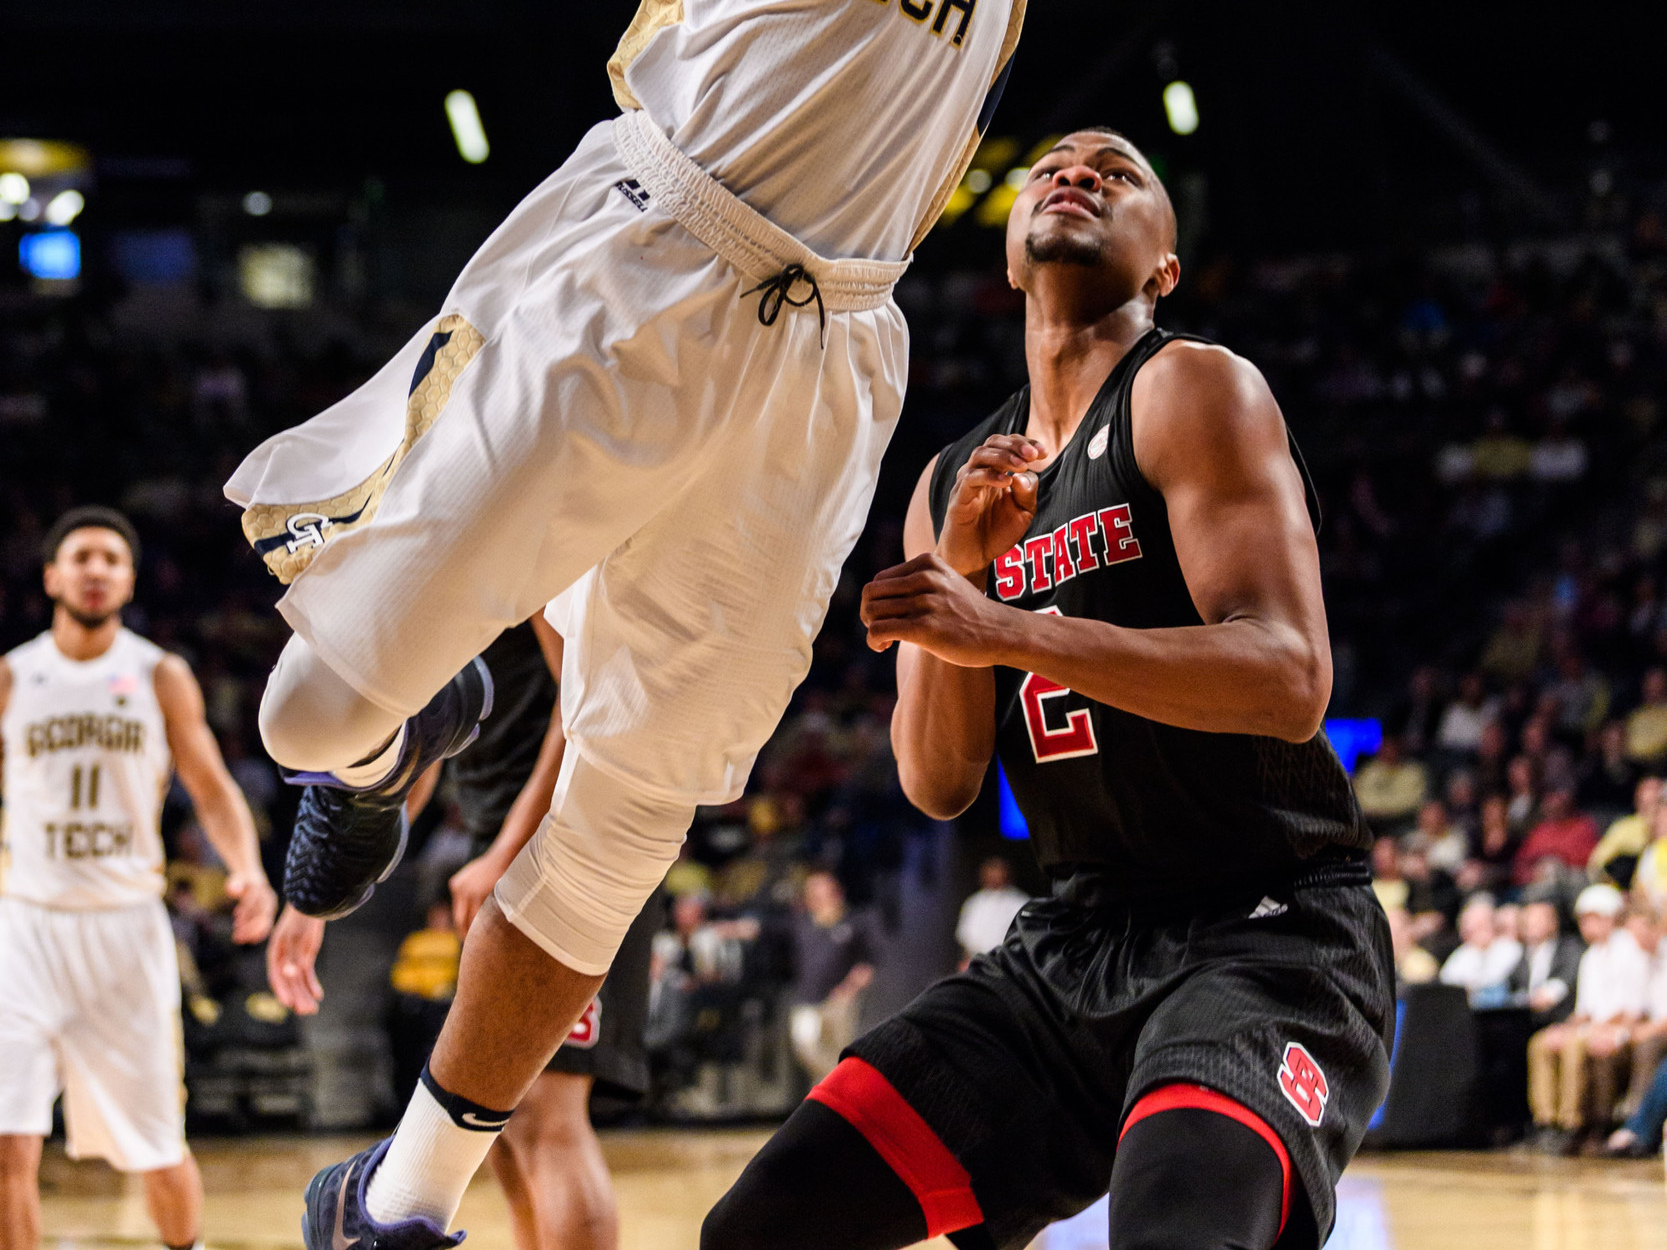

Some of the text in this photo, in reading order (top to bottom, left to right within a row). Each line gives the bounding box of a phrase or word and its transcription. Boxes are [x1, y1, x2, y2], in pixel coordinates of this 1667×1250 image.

[994, 502, 1143, 601] STATE
[71, 763, 99, 810] 11
[44, 822, 132, 860] TECH
